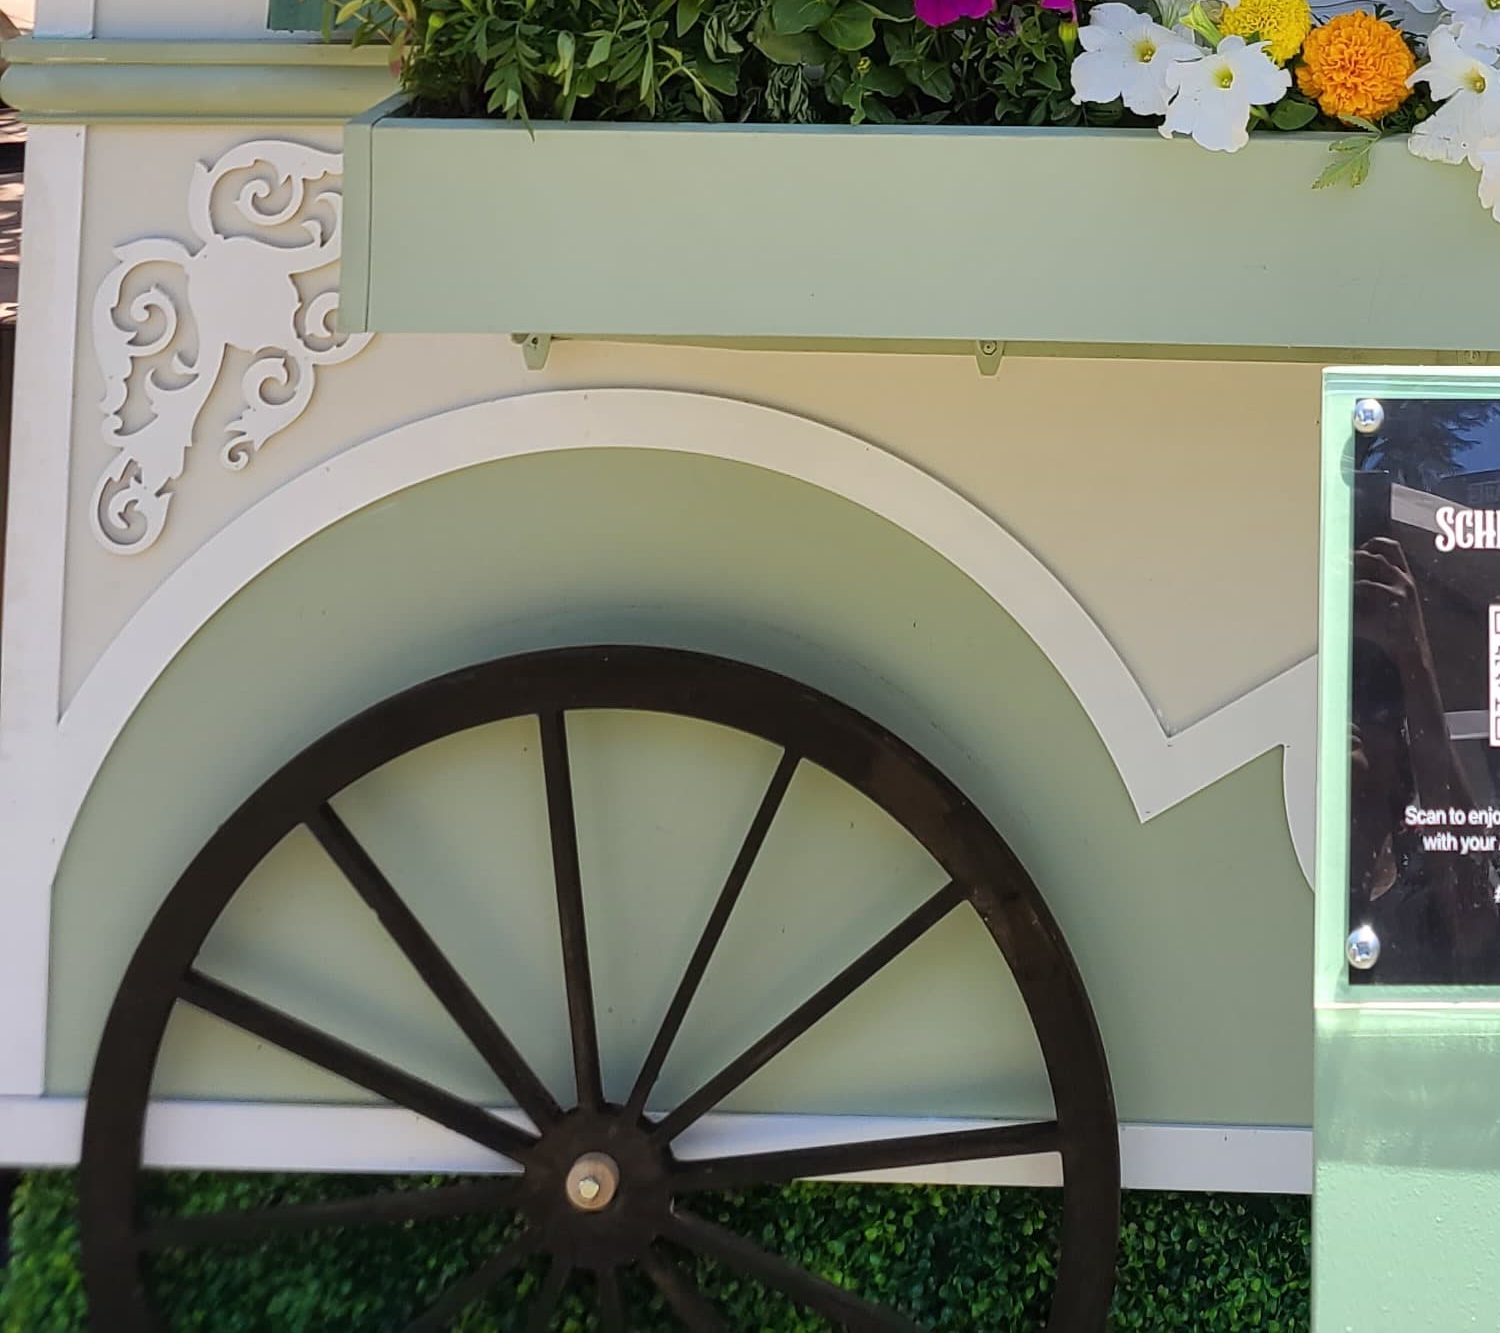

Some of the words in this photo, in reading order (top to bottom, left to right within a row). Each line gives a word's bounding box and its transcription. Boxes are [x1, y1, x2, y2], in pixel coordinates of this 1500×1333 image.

[1404, 805, 1447, 826] Scan
[1449, 806, 1466, 826] to
[1422, 832, 1458, 851] with
[1460, 836, 1497, 855] your
